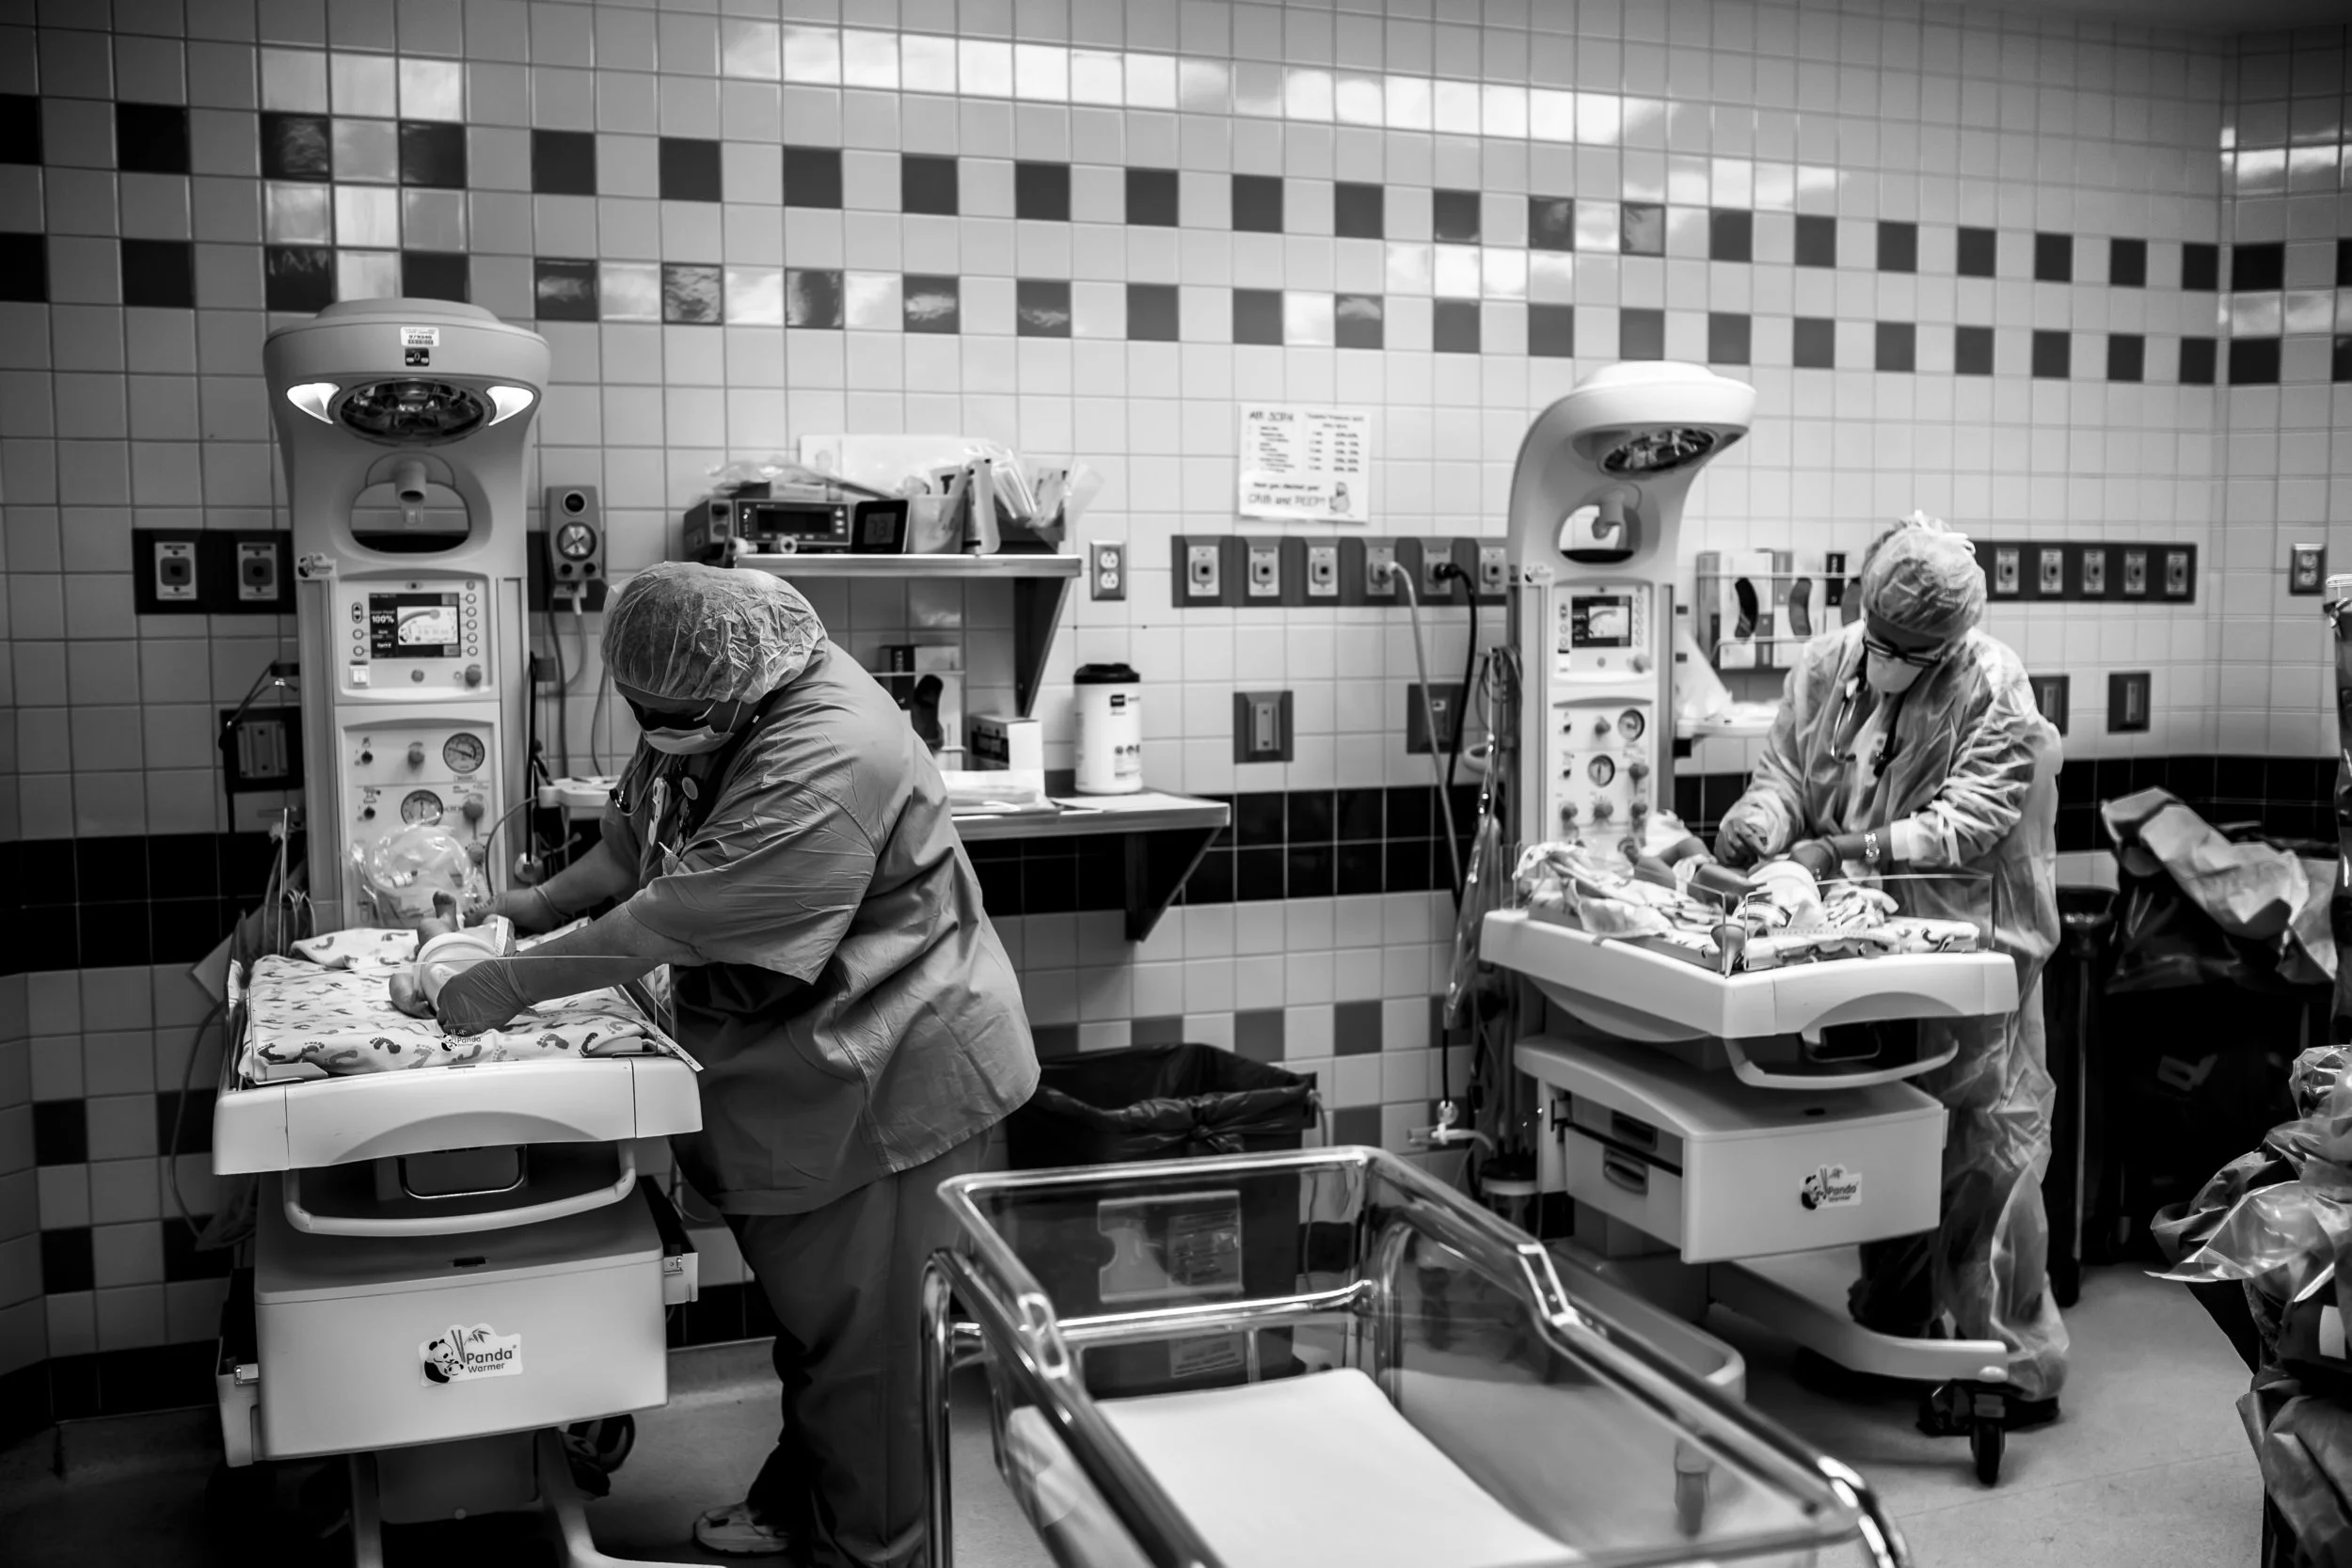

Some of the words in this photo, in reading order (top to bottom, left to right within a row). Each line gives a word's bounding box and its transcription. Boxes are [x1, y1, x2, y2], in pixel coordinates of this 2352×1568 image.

[372, 614, 395, 625] 100%
[1827, 1184, 1857, 1196] Panda
[466, 1347, 513, 1365] Panda
[468, 1362, 505, 1373] Warmer
